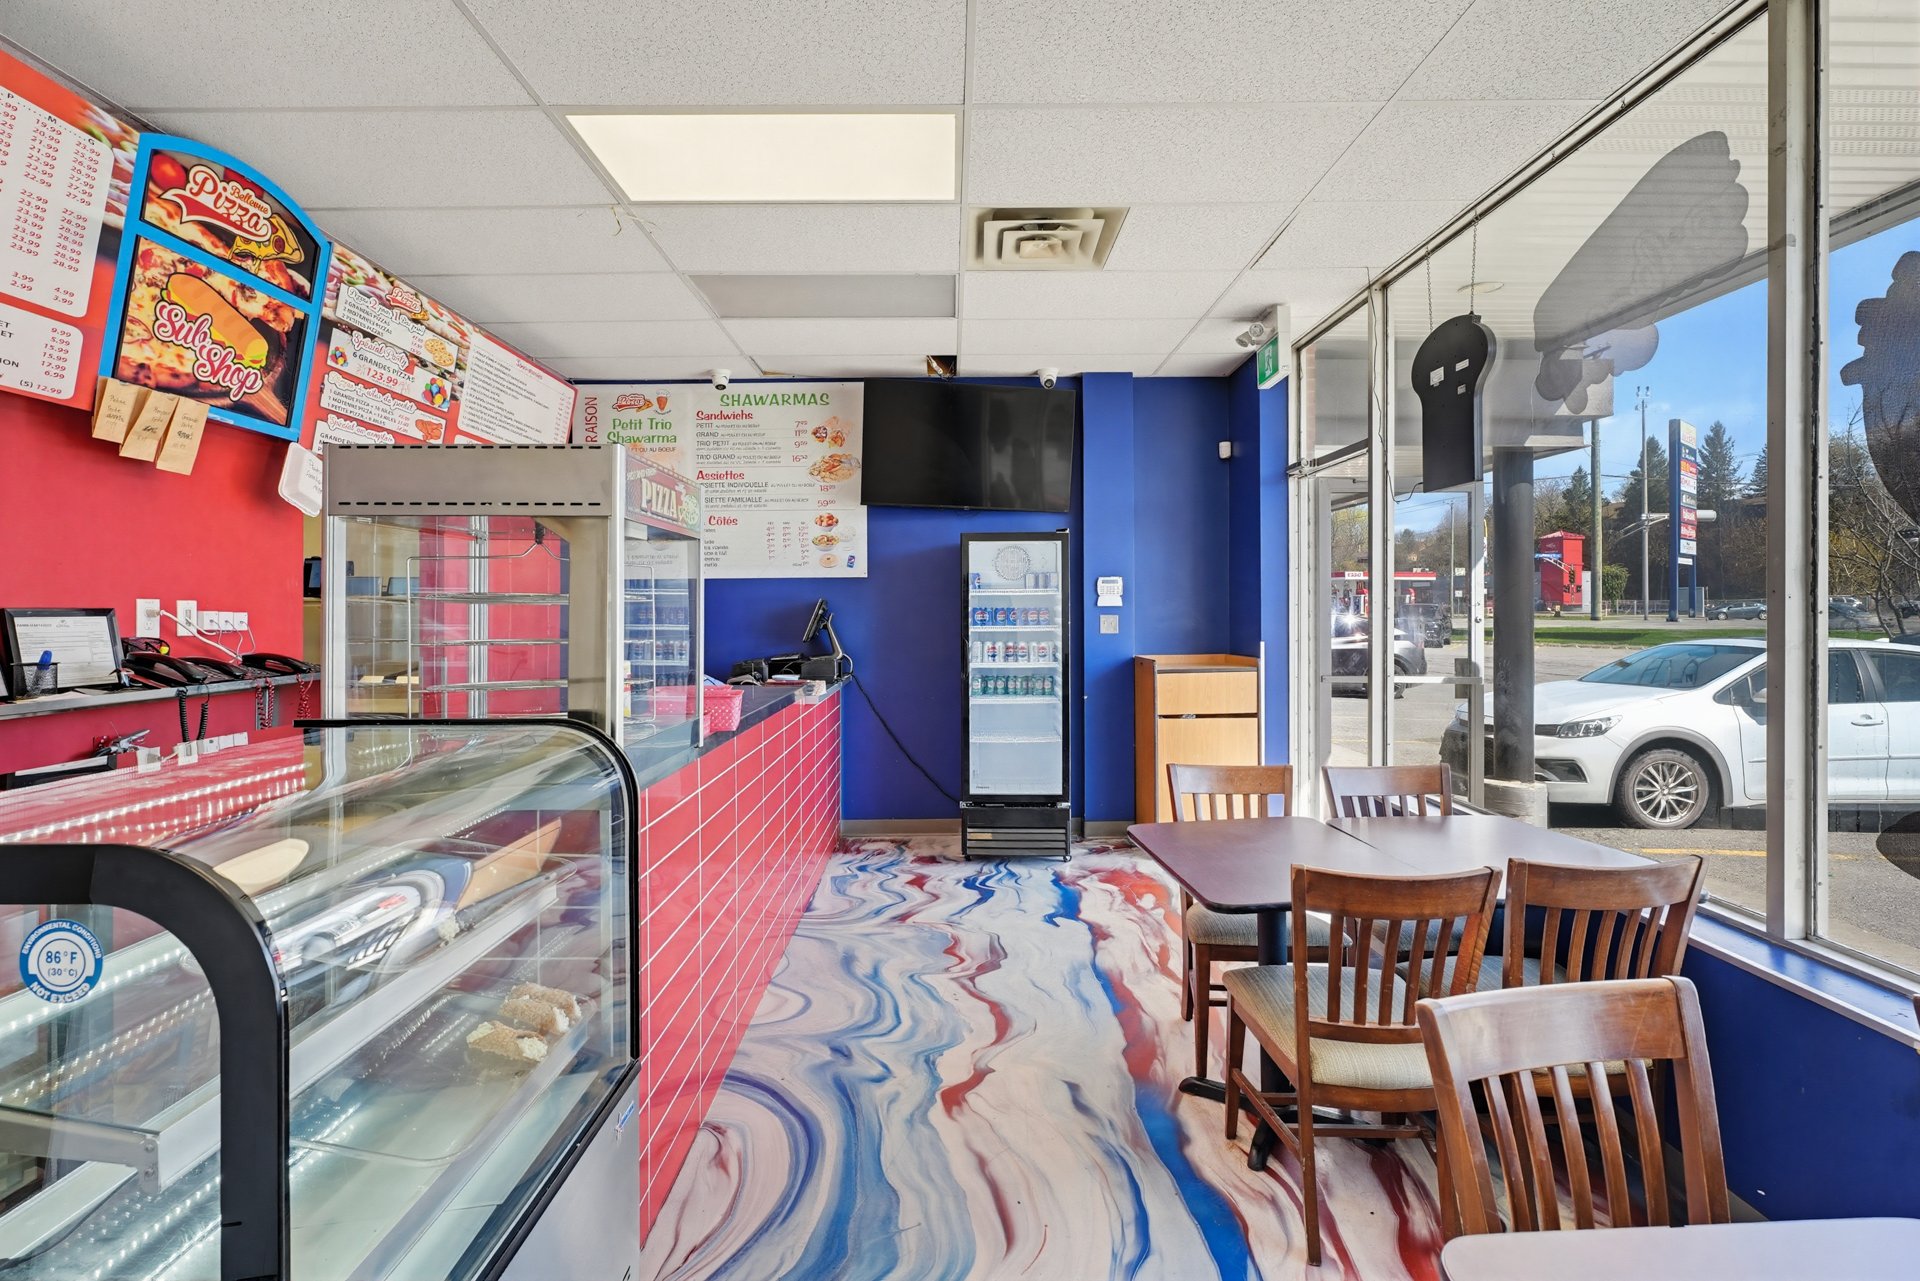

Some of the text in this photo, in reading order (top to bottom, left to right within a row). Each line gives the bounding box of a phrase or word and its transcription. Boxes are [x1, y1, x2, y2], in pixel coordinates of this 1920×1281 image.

[48, 116, 56, 124] M
[33, 128, 60, 143] 20.99
[74, 149, 98, 164] 25.99
[36, 119, 62, 135] 19.99
[76, 141, 100, 156] 23.99
[29, 145, 56, 161] 21.99
[71, 166, 95, 181] 26.99
[31, 136, 58, 152] 21.99
[72, 157, 97, 173] 26.99
[26, 162, 92, 197] 22.99 27.99
[27, 153, 94, 189] 22.99 27.99
[24, 171, 91, 206] 22.99 27.99
[189, 170, 268, 232] Pizza
[230, 185, 268, 214] Bellevue
[18, 198, 86, 230] 23.99 28.99
[20, 189, 87, 222] 22.99 27.99
[14, 225, 41, 239] 23.99
[15, 215, 83, 246] 23.99 28.99
[17, 207, 84, 238] 23.99 28.99
[10, 242, 78, 272] 23.99 28.99
[12, 234, 80, 263] 23.99 28.99
[10, 280, 73, 305] 2.99 3.99
[12, 272, 74, 297] 3.99 4.99
[51, 328, 71, 337] 9.99
[157, 305, 209, 347] Sub
[44, 344, 69, 354] 15.99
[51, 337, 70, 346] 5.99
[42, 361, 66, 371] 17.99
[43, 352, 68, 362] 15.99
[197, 344, 262, 398] Shop
[358, 354, 390, 373] GRANDES
[392, 369, 414, 382] PIZZAS
[37, 384, 62, 394] 12.99
[720, 392, 830, 406] SHAWARMAS
[585, 397, 597, 443] RAISON
[612, 418, 672, 430] Petit Trio
[320, 433, 346, 443] GRANDE
[607, 431, 677, 444] Shawarma
[697, 470, 744, 480] Assiettes
[641, 478, 678, 518] PIZZA
[708, 515, 738, 525] Côtés
[22, 922, 71, 954] ENVIRONMENTAL
[30, 982, 90, 1003] NOT EXCEED
